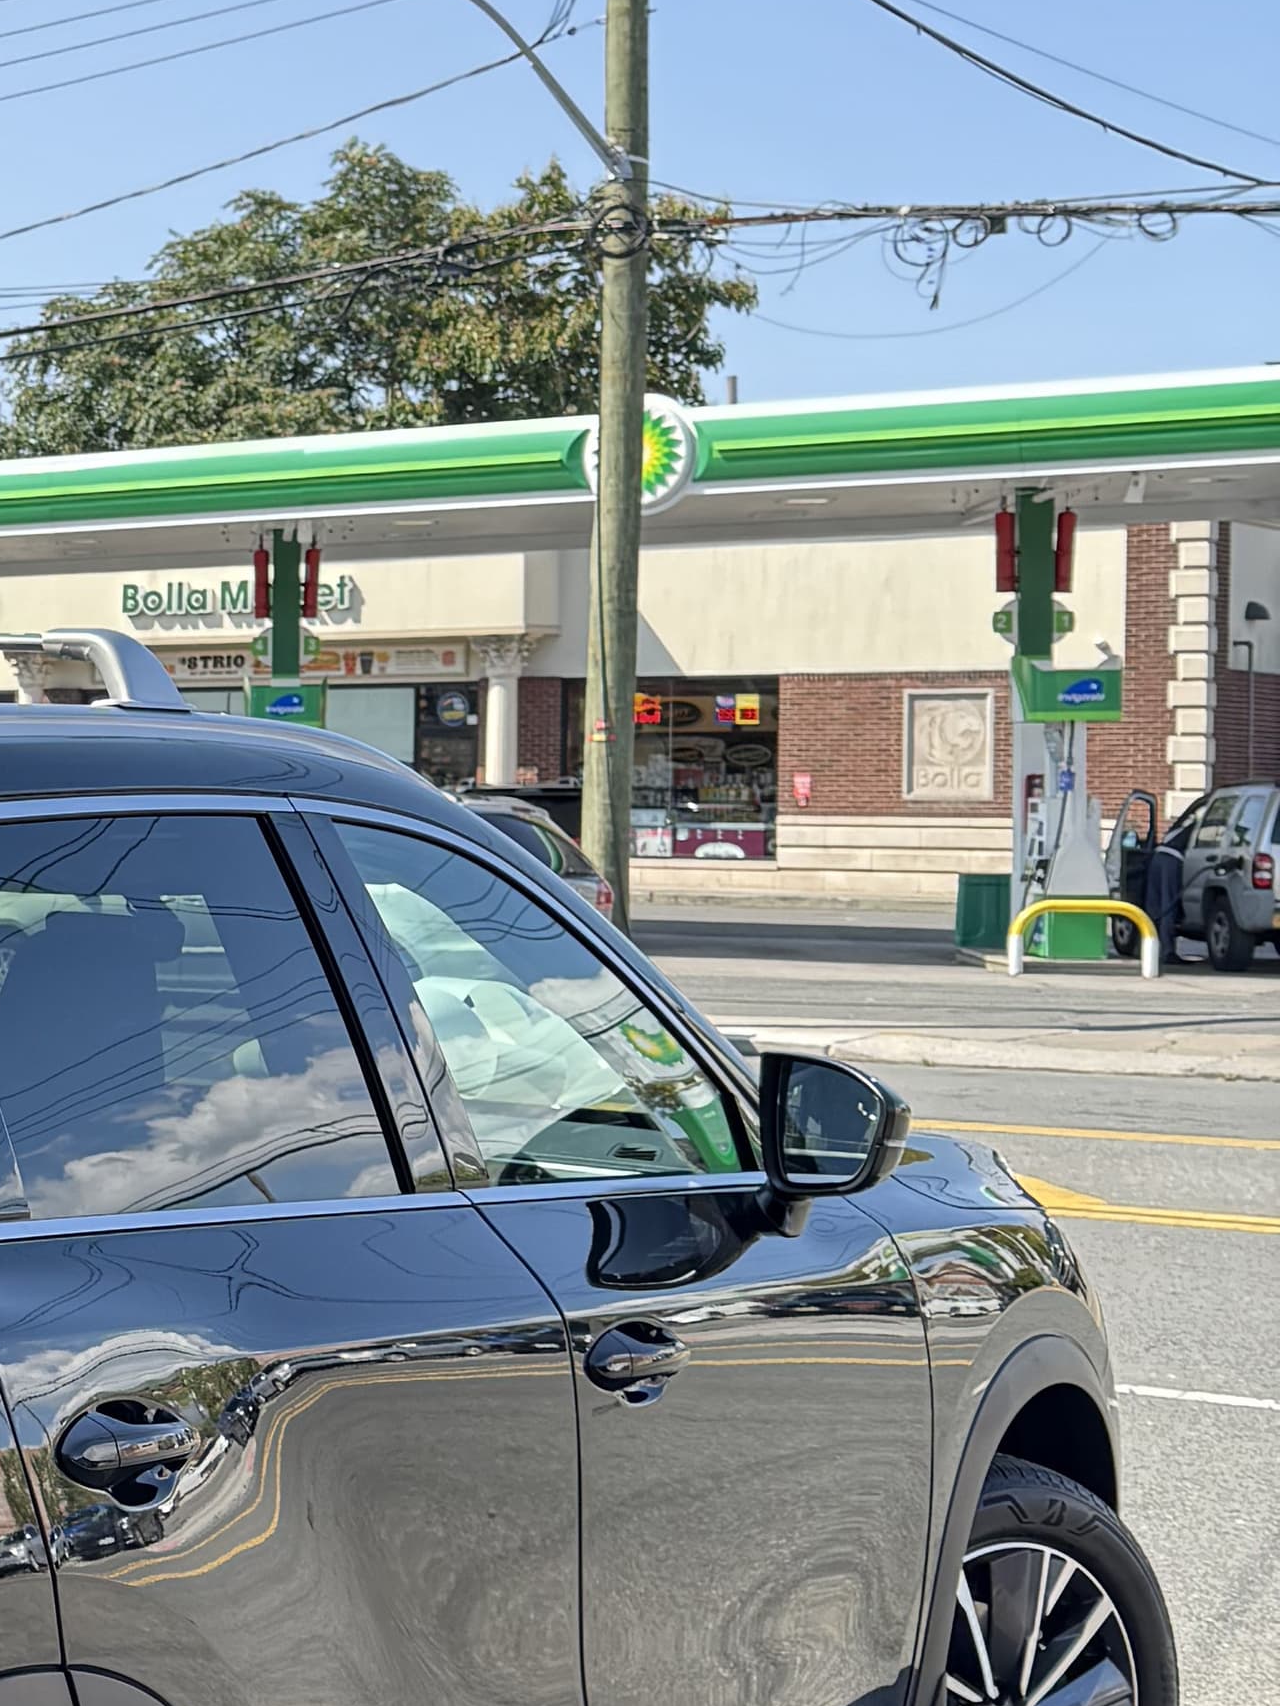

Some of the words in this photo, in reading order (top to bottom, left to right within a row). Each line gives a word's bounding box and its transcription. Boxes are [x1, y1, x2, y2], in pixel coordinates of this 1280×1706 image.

[122, 580, 209, 615] Bolla
[220, 574, 350, 614] Met
[996, 614, 1007, 629] 2
[1061, 614, 1070, 629] 1
[199, 654, 245, 670] TRIO
[915, 764, 983, 790] Bolla
